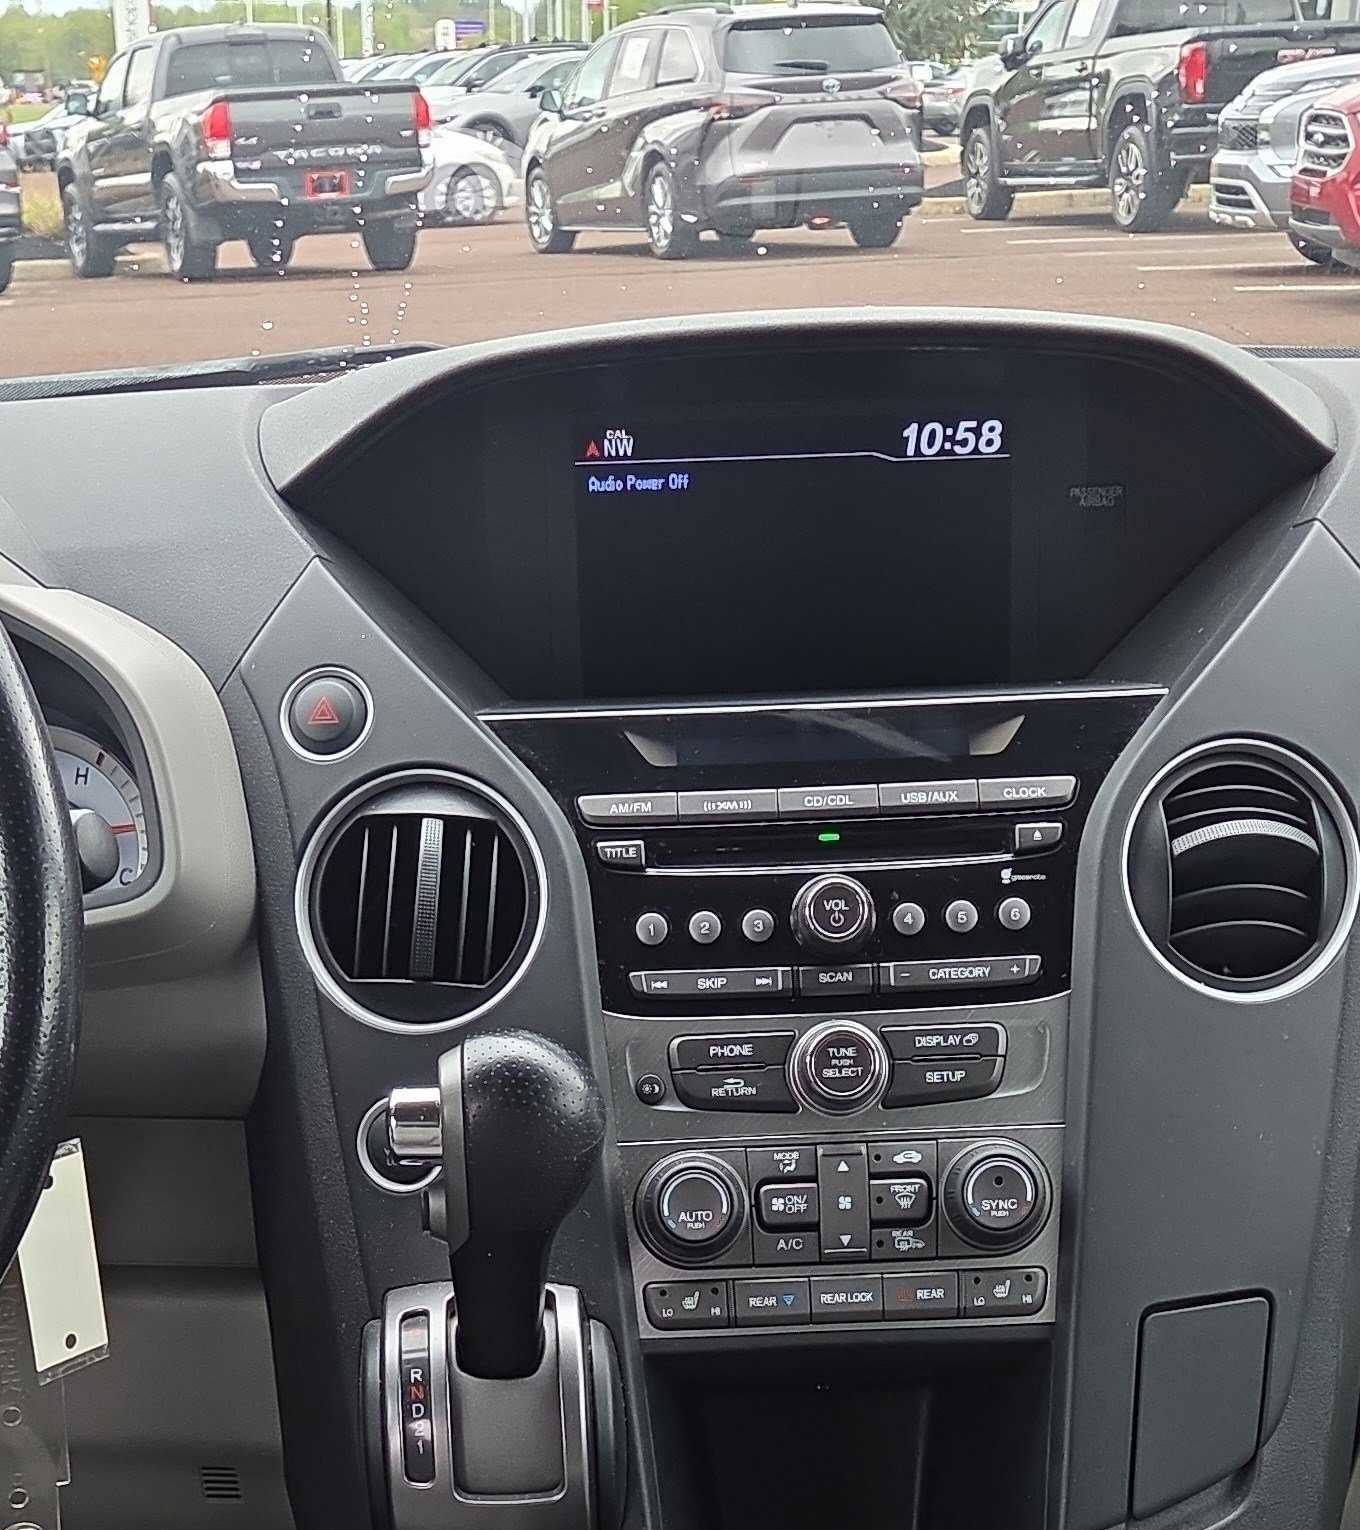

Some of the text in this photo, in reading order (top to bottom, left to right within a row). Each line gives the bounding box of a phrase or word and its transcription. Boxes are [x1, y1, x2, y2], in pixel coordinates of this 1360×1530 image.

[606, 429, 629, 439] CAL
[902, 420, 1002, 456] 10:58
[603, 438, 634, 457] NW
[588, 473, 689, 492] Audio Power Off
[75, 767, 89, 785] H
[609, 801, 652, 814] AM/FM
[803, 793, 854, 807] CD/CDL
[900, 790, 958, 804] USB/AUX
[1003, 786, 1047, 798] CLOCK
[605, 847, 637, 858] TITLE
[119, 867, 133, 886] C
[823, 899, 850, 911] VOL
[648, 907, 1020, 937] 1 2 3 4 5 6
[697, 965, 991, 990] SKIP SCAN CATEGORY
[914, 1034, 962, 1048] DISPLAY
[709, 1044, 754, 1058] PHONE
[826, 1046, 858, 1057] TUNE
[831, 1058, 854, 1066] PUSH
[822, 1066, 864, 1078] SELECT
[925, 1070, 966, 1083] SETUP
[711, 1085, 757, 1098] RETURN
[773, 1151, 800, 1161] MODE
[890, 1184, 921, 1194] FRONT
[785, 1194, 808, 1205] ON/
[981, 1198, 1018, 1211] SYNC
[785, 1204, 808, 1214] OFF
[678, 1210, 713, 1223] AUTO
[891, 1229, 914, 1238] REAR
[776, 1238, 803, 1252] A/C
[820, 1292, 874, 1304] REAR LOCK
[916, 1288, 945, 1301] REAR
[973, 1294, 1033, 1306] LO HI
[748, 1296, 778, 1308] REAR
[662, 1306, 721, 1318] LO HI
[410, 1368, 423, 1384] R
[410, 1385, 425, 1401] N
[411, 1403, 425, 1419] D
[414, 1422, 426, 1437] 2
[416, 1439, 424, 1455] 1
